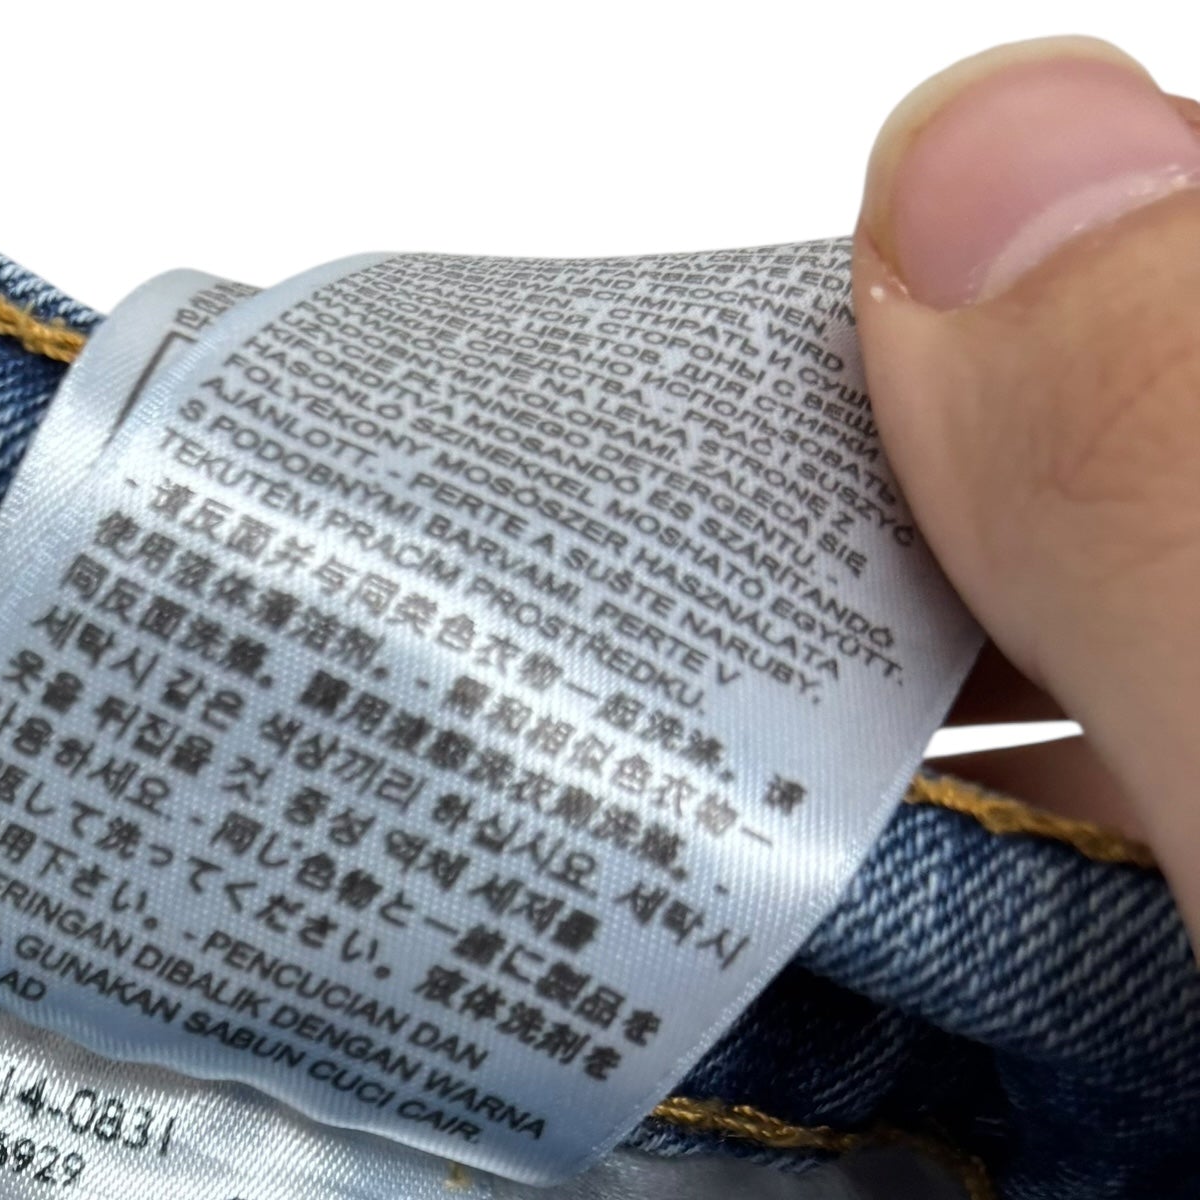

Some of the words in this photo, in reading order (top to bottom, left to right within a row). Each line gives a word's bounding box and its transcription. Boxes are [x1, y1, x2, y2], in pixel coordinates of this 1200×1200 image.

[522, 321, 666, 371] ЦВЕТОВ.
[672, 362, 749, 401] ДЛЯ
[597, 321, 766, 386] СТОРОНЫ
[607, 307, 760, 358] СТИРАТЬ
[766, 351, 793, 372] И
[648, 282, 829, 342] TROCKNEN.
[766, 321, 845, 373] WIRD
[198, 375, 379, 474] AJÁNLOTT.
[220, 352, 433, 461] FOLYÉKONY
[294, 300, 494, 391] PODOBNYMI
[497, 383, 682, 466] KOLORAMI.
[690, 459, 812, 538] ZALECA
[538, 376, 587, 405] NA
[240, 334, 408, 422] HASONLÓ
[601, 498, 769, 602] MOSHATÓ
[462, 412, 645, 498] MOSANDÓ
[644, 485, 697, 525] ÉS
[595, 442, 815, 575] DETERGENTU.
[157, 427, 322, 523] TEKUTÉM
[464, 573, 709, 716] PROSTŘEDKU.
[179, 396, 207, 424] S
[204, 412, 421, 526] PODOBNÝMI
[591, 599, 711, 674] PERTE
[717, 661, 742, 686] V
[406, 470, 530, 541] PERTE
[531, 532, 556, 552] A
[561, 545, 683, 622] SUŠTE
[0, 645, 86, 717] 옷을
[86, 690, 217, 778] 뒤집을
[279, 782, 376, 853] 중성
[375, 826, 471, 895] 액체
[465, 866, 603, 954] 세제를
[29, 600, 162, 692] 세탁시
[158, 665, 249, 732] 같은
[254, 707, 428, 814] 색상끼리
[611, 874, 751, 971] 세탁시
[12, 930, 184, 1024] GUNAKAN
[182, 1005, 308, 1075] SABUN
[304, 1054, 396, 1110] CUCI
[394, 1093, 486, 1147] CAIR.
[130, 941, 273, 1021] DIBALIK
[269, 1002, 423, 1084] DENGAN
[421, 1066, 547, 1142] WARNA
[199, 928, 411, 1037] PENCUCIAN
[407, 1019, 491, 1073] DAN
